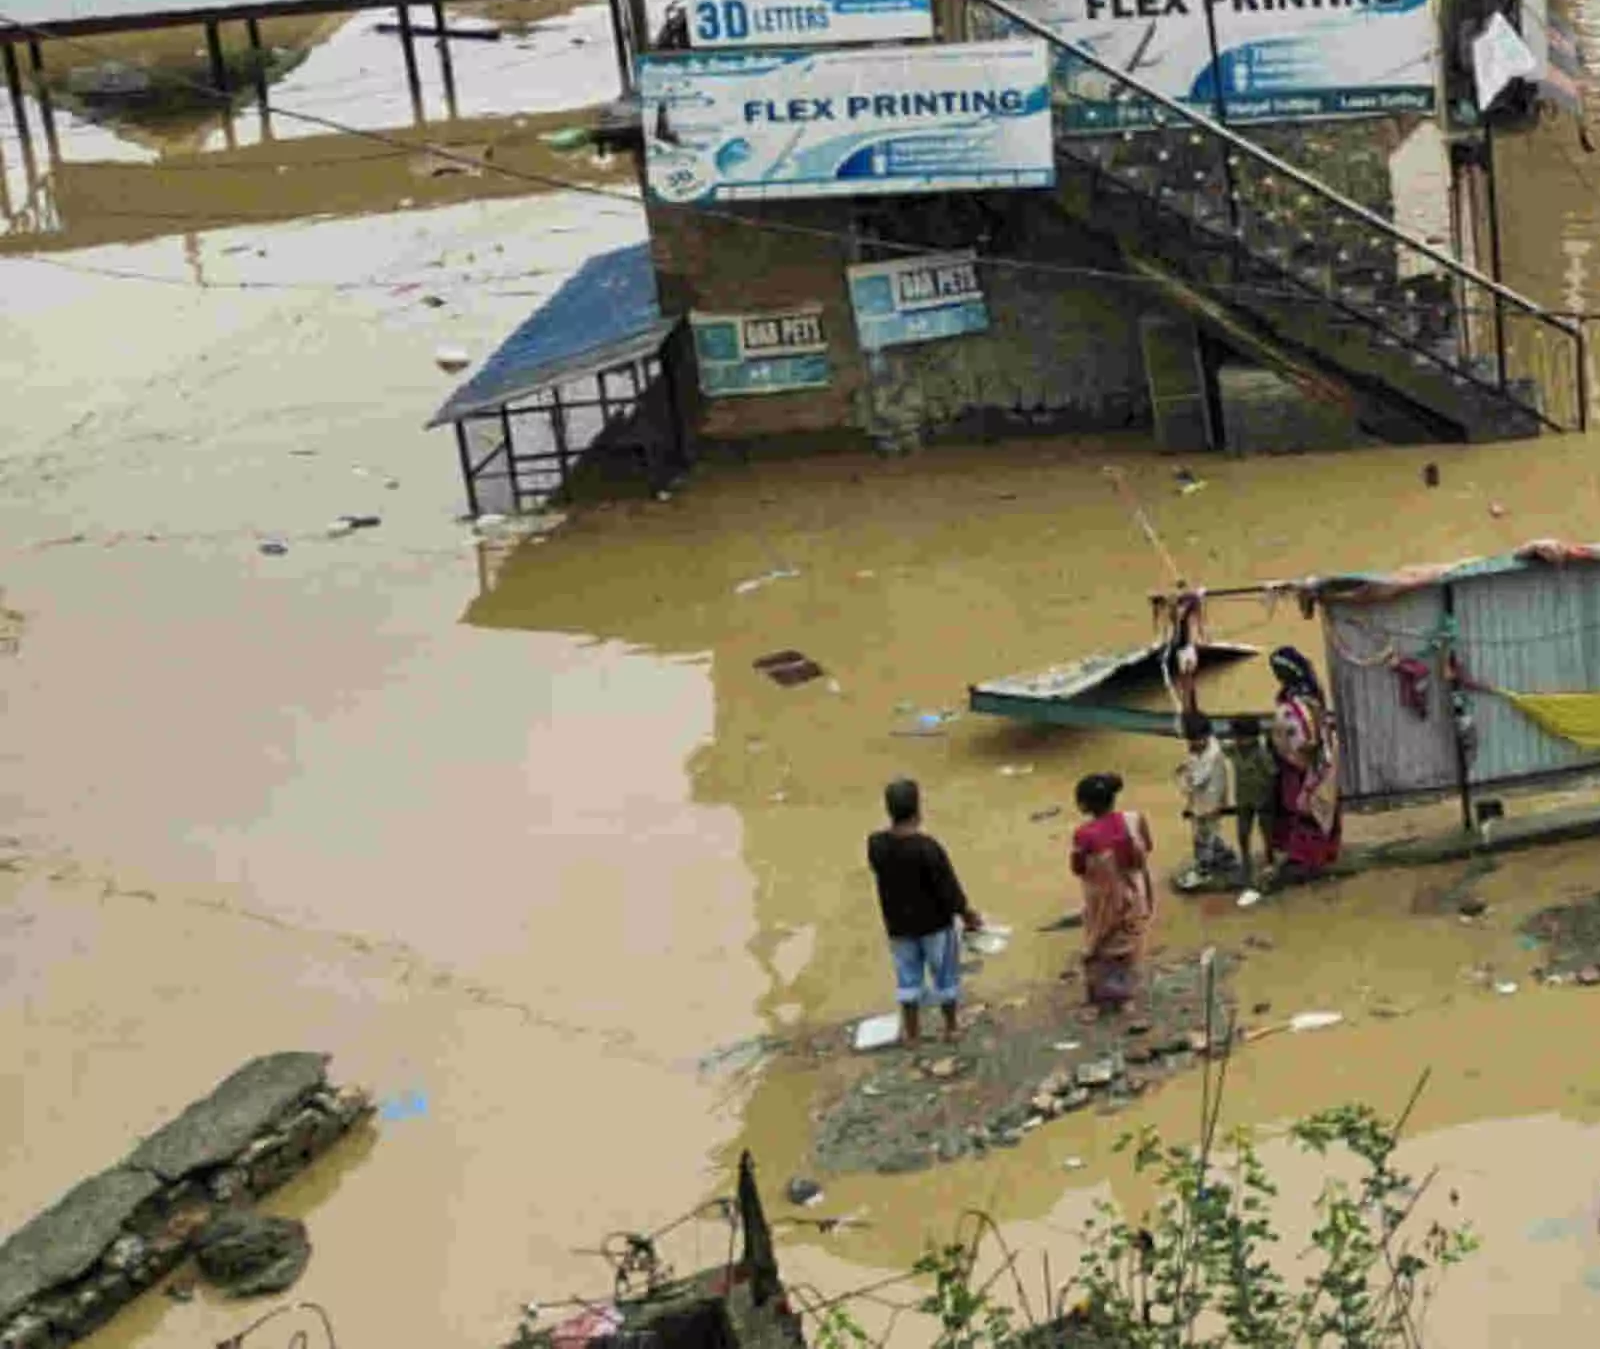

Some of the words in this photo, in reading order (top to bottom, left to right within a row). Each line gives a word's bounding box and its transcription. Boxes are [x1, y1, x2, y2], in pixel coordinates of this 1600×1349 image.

[696, 0, 749, 40] 3D
[753, 4, 830, 33] LETTERS
[743, 97, 836, 124] FLEX
[847, 89, 1024, 119] PRINTING
